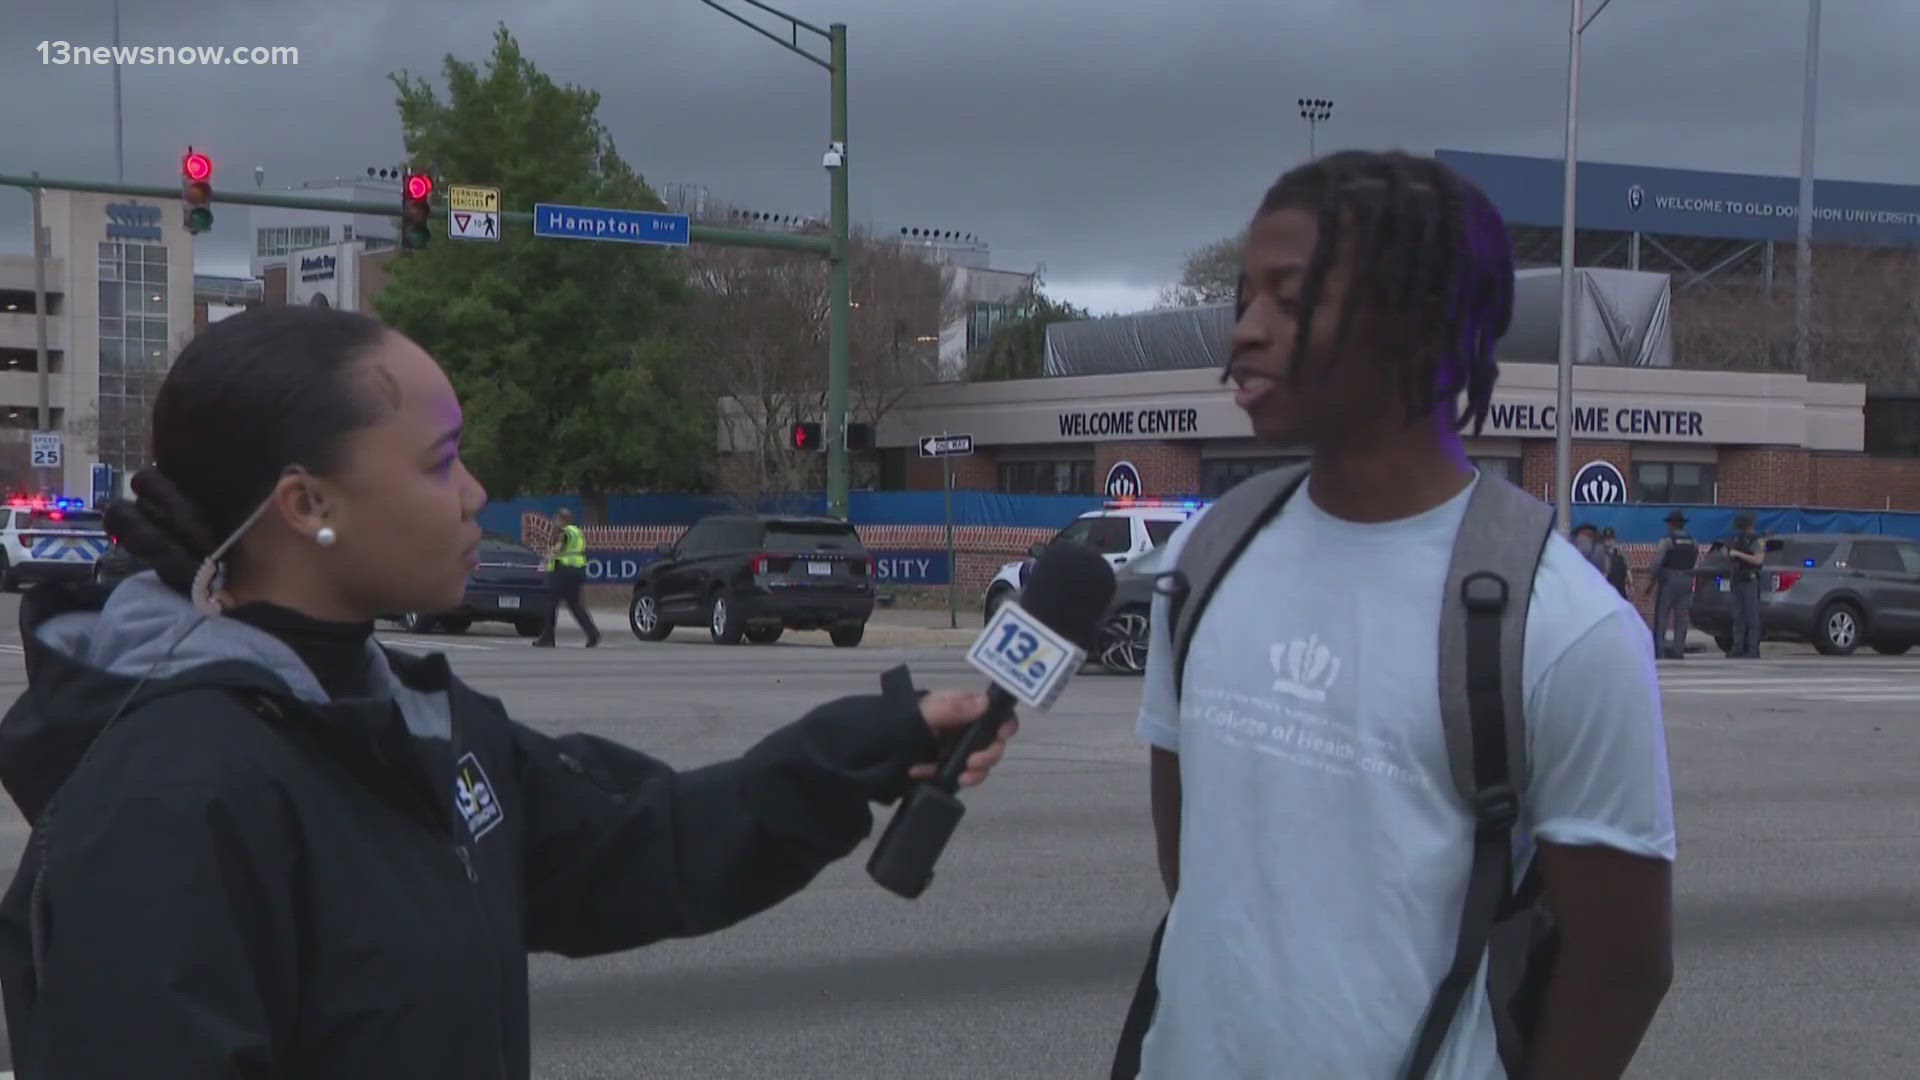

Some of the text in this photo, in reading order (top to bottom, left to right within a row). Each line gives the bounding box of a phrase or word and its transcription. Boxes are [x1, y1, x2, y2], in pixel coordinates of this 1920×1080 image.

[452, 189, 483, 198] TURNING
[452, 198, 484, 207] VEHICLES
[1656, 195, 1722, 212] WELCOME
[1725, 201, 1743, 213] TO
[1745, 203, 1773, 216] OLD
[1776, 206, 1842, 220] DONION
[550, 212, 675, 235] Hampton Blvd
[1059, 408, 1198, 437] WELCOME CENTER
[1491, 404, 1703, 436] WELCME CENTER
[34, 451, 58, 464] 25
[585, 559, 637, 578] OLD
[995, 623, 1038, 664] 13
